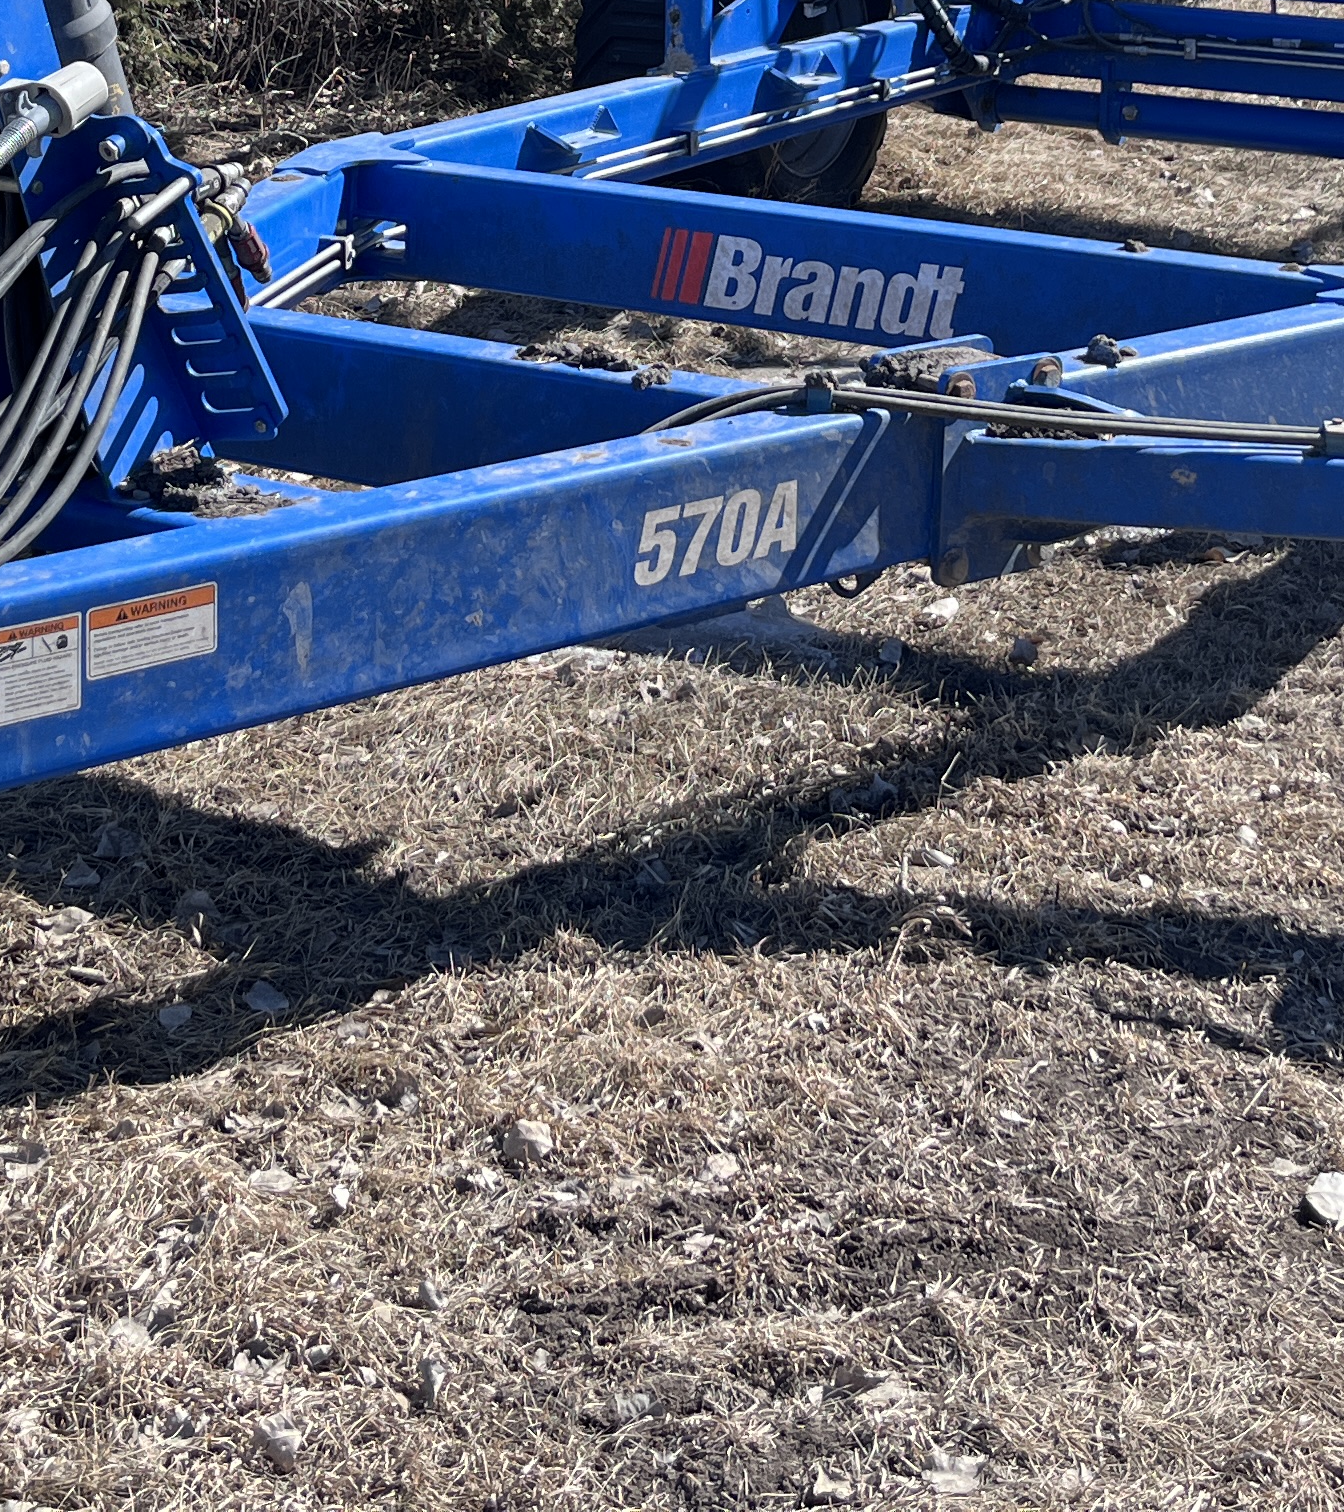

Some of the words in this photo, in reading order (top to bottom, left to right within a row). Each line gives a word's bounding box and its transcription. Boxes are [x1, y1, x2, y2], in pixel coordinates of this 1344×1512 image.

[703, 234, 965, 340] Brandt
[634, 479, 799, 587] 570A
[19, 621, 64, 638] WARNING
[130, 595, 188, 617] WARNING
